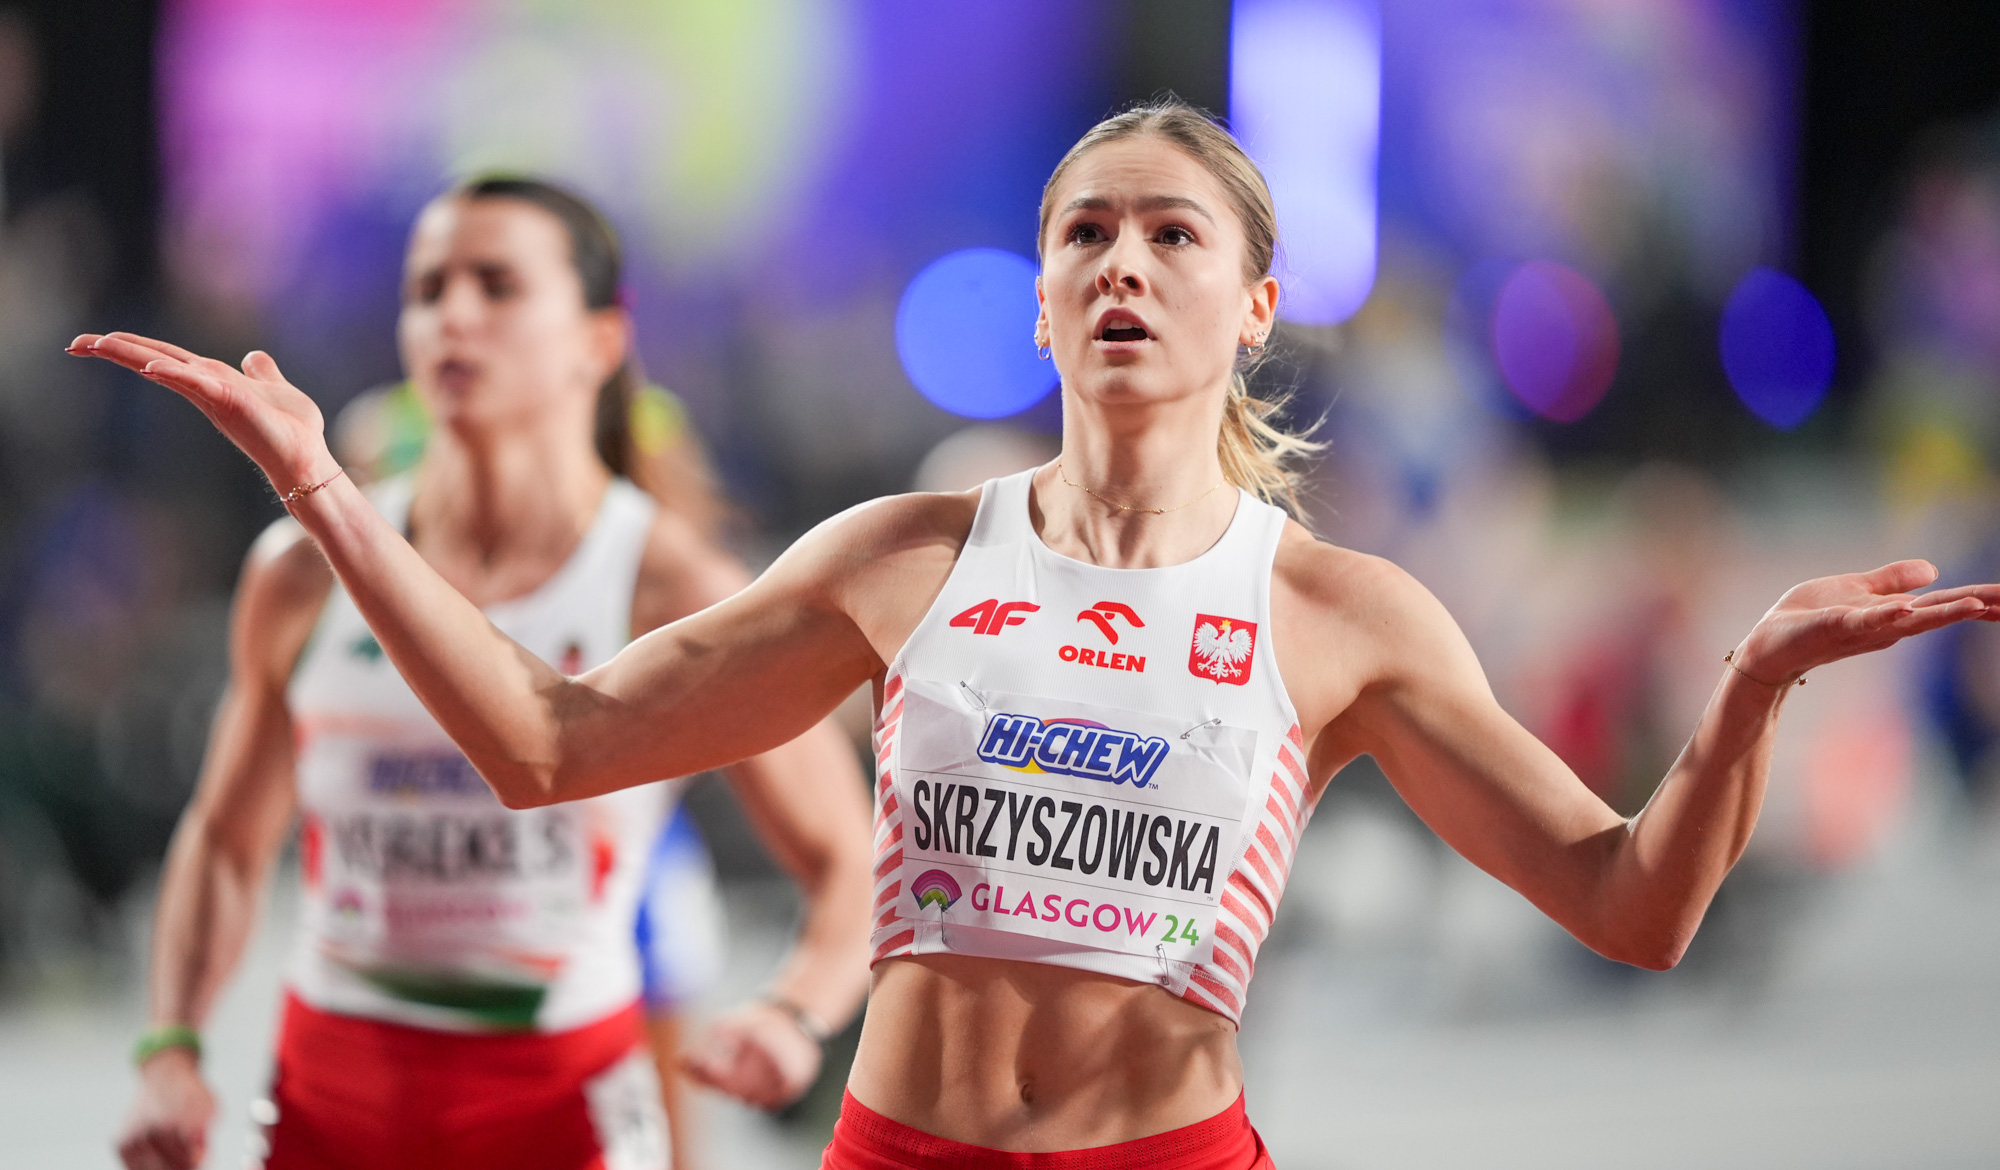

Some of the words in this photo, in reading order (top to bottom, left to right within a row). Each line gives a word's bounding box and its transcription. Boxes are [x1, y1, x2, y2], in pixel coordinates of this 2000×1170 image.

[949, 599, 1040, 636] 4F
[1058, 645, 1147, 673] ORLEN
[978, 714, 1169, 788] HI-CHEW
[913, 779, 1220, 895] SKRZYSZOWSKA
[971, 882, 1158, 937] GLASGOW
[1160, 914, 1200, 946] 24
